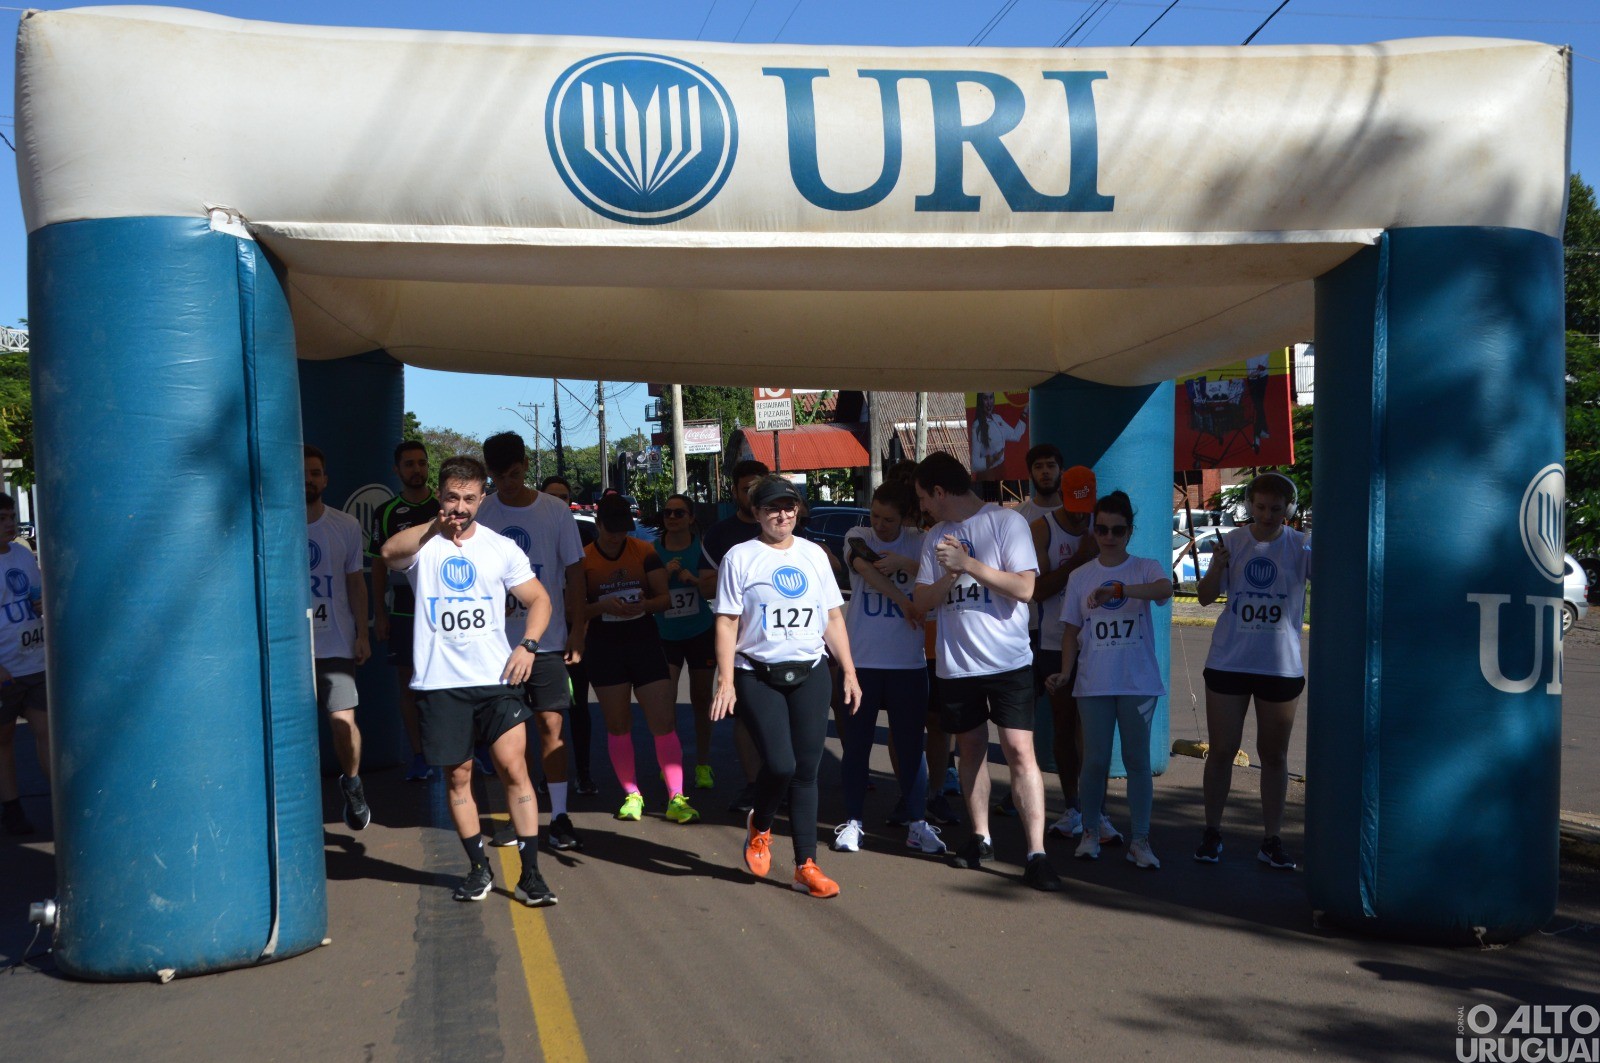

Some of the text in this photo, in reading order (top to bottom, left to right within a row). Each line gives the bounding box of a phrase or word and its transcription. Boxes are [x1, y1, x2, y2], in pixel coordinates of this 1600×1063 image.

[763, 68, 1114, 212] URI
[756, 401, 790, 410] RESTAURANTE
[758, 409, 790, 419] E PIZZARIA
[758, 420, 766, 430] DO
[310, 575, 333, 598] RI
[616, 580, 641, 588] Forma
[947, 583, 980, 604] 114
[1, 598, 42, 623] UR
[863, 592, 913, 618] UR
[1241, 604, 1282, 623] 049
[441, 608, 486, 631] 068
[772, 608, 813, 629] 127
[1095, 619, 1135, 640] 017
